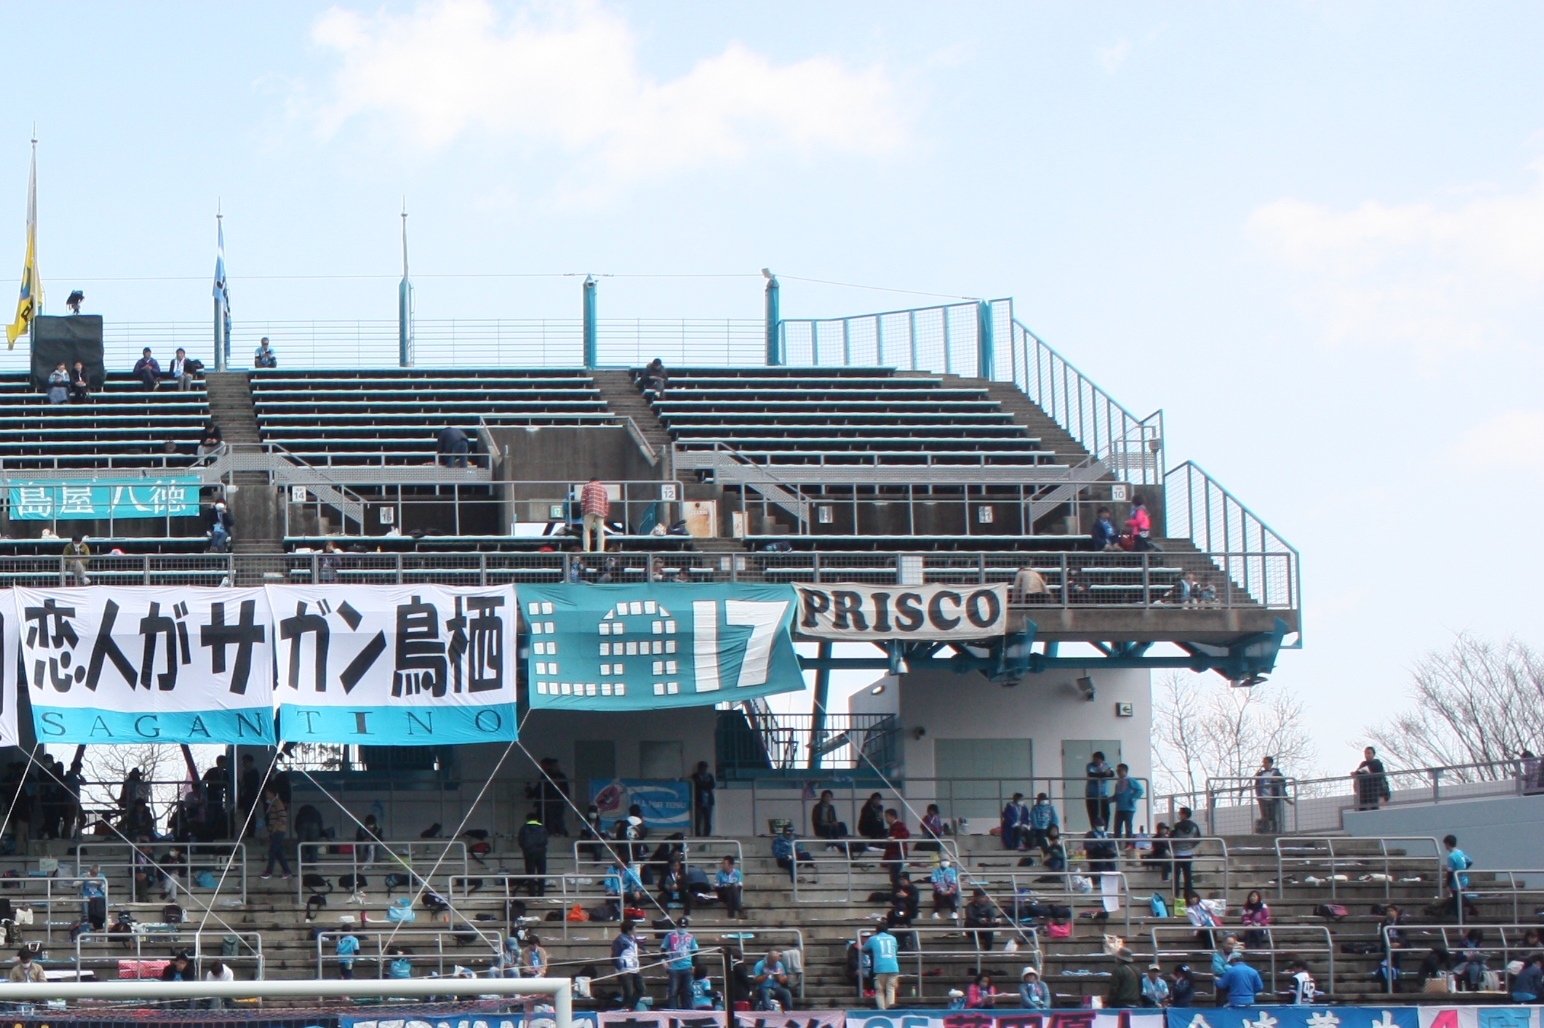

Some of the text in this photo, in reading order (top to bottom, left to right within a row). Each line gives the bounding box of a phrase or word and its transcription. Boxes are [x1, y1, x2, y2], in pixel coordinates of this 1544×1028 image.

[15, 478, 187, 517] 島屋八徳
[293, 492, 304, 500] 14
[663, 490, 674, 499] 12
[1113, 490, 1124, 499] 10
[801, 588, 1001, 633] PRISCO
[24, 595, 506, 699] 恋人がサガン鳥栖
[880, 940, 892, 955] 11
